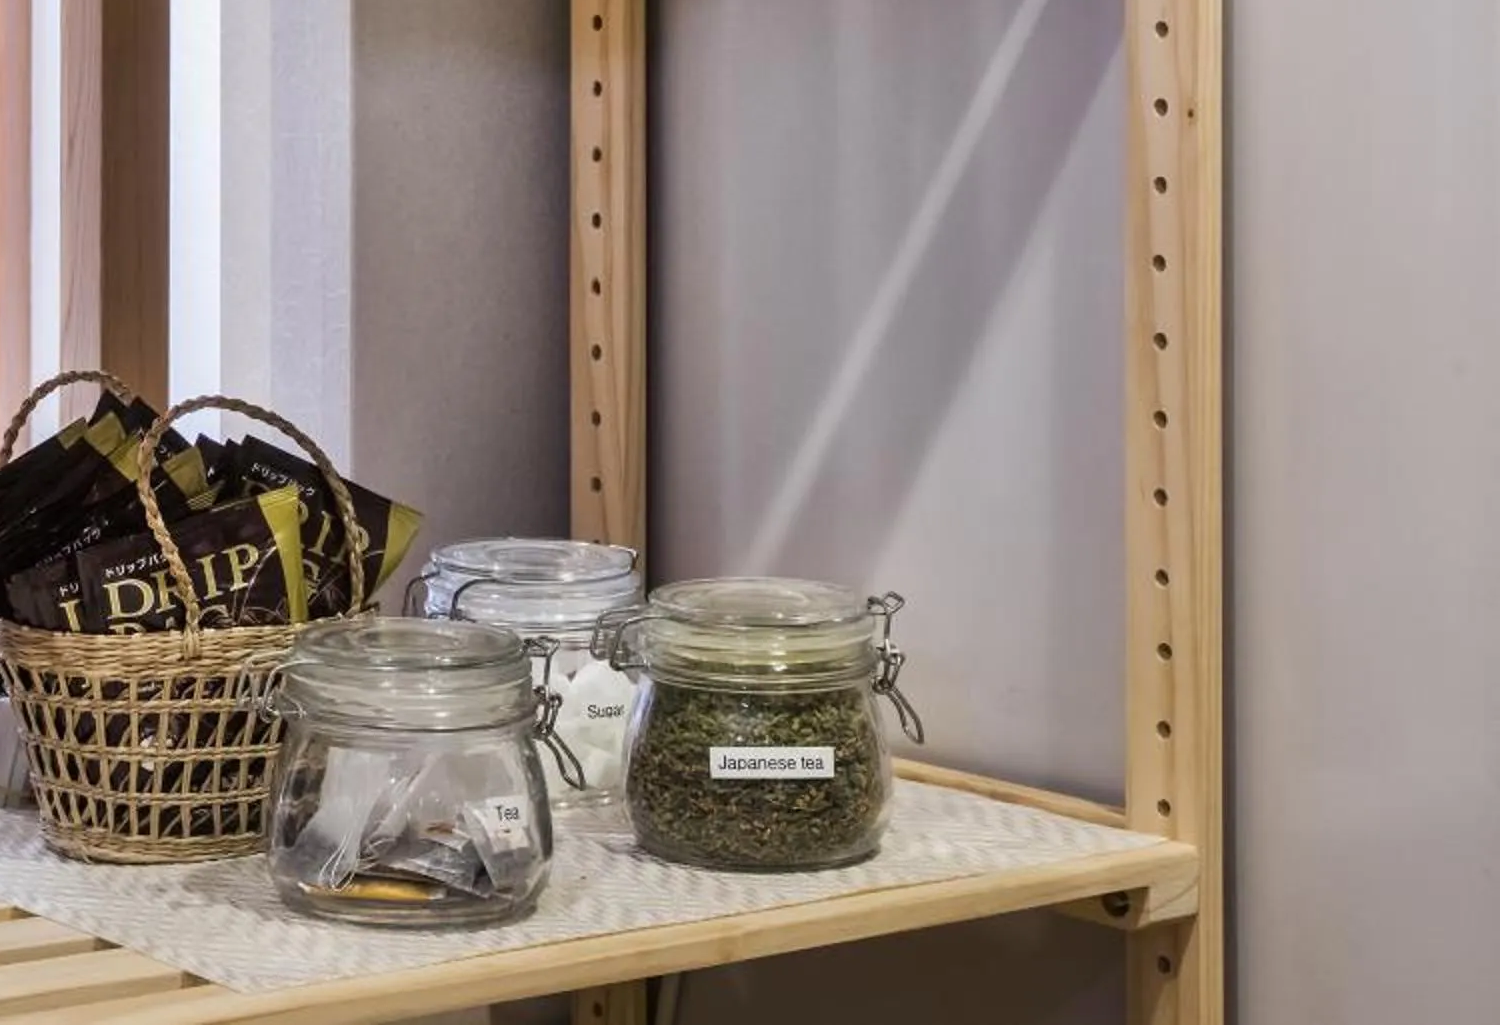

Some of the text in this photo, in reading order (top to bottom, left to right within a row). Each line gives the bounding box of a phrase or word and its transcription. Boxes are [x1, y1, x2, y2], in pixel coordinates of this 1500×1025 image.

[587, 704, 625, 719] Sugar
[719, 755, 824, 770] Japanese tea
[495, 805, 520, 821] Tea
